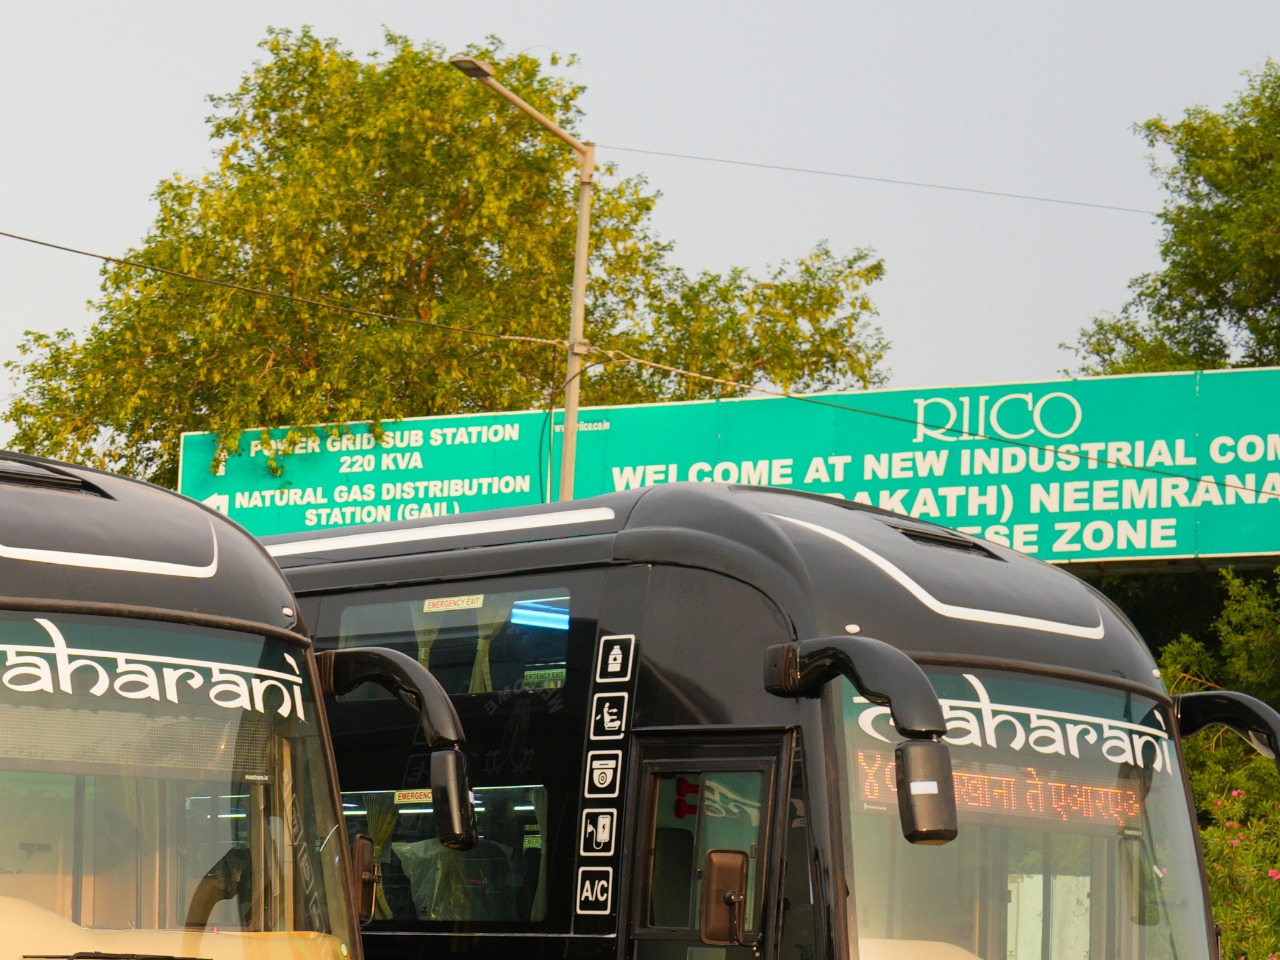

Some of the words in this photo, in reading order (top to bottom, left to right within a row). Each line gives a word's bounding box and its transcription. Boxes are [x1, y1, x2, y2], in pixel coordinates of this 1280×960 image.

[912, 392, 1082, 443] RIICO
[326, 431, 376, 453] GRID
[381, 429, 424, 450] SUB
[429, 423, 520, 447] STATION
[339, 454, 375, 473] 220
[381, 451, 423, 471] KVA
[803, 455, 852, 483] AT
[864, 450, 949, 481] NEW
[960, 438, 1197, 476] INDUSTRIAL
[234, 487, 328, 509] NATURAL
[333, 484, 375, 504] GAS
[381, 475, 531, 501] DISTRIBUTION
[1030, 472, 1280, 514] NEEMRANA
[304, 505, 391, 527] STATION
[1052, 518, 1177, 552] ZONE
[427, 599, 465, 610] EMERGENCY
[466, 597, 480, 606] EXIT
[397, 791, 432, 801] EMERGENC
[581, 881, 608, 902] A/C
